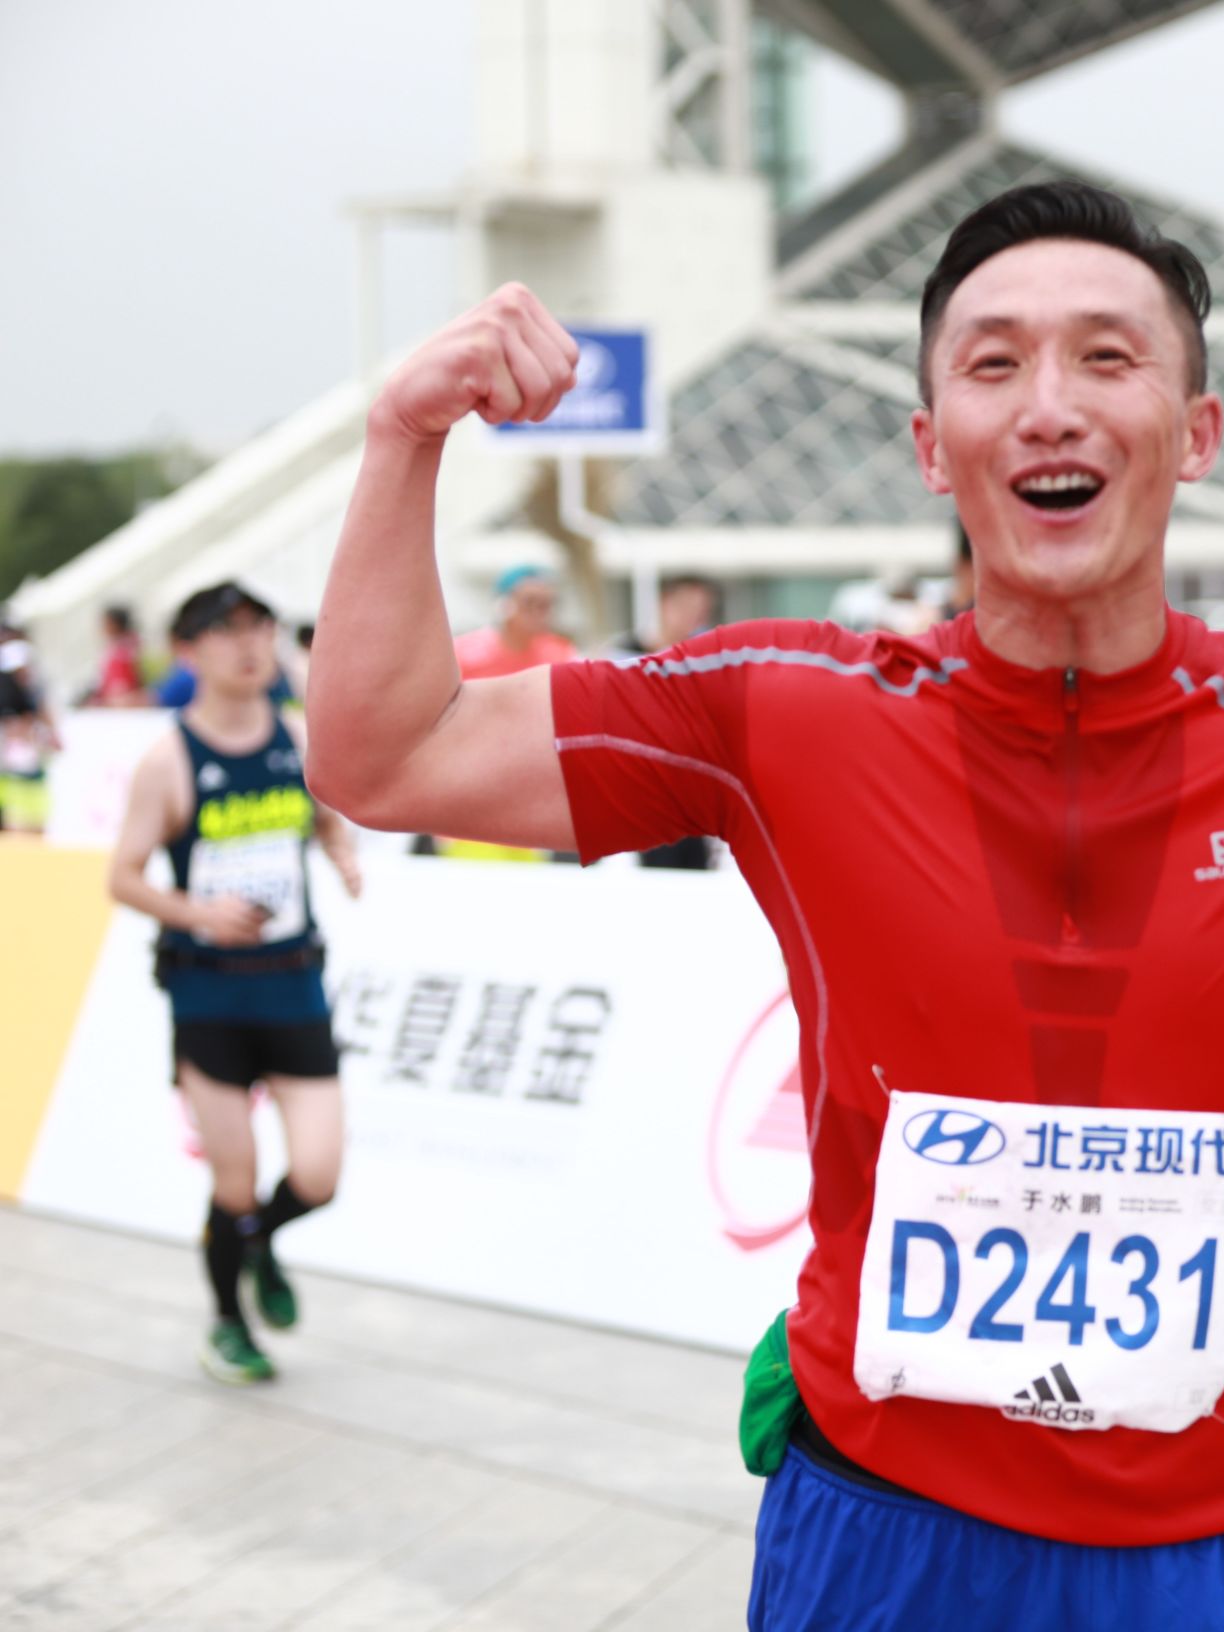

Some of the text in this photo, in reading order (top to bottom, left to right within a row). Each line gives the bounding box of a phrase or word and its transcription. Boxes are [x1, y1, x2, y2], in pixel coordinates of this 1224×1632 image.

[1022, 1188, 1102, 1215] 于水鹏
[887, 1218, 1218, 1351] D2431
